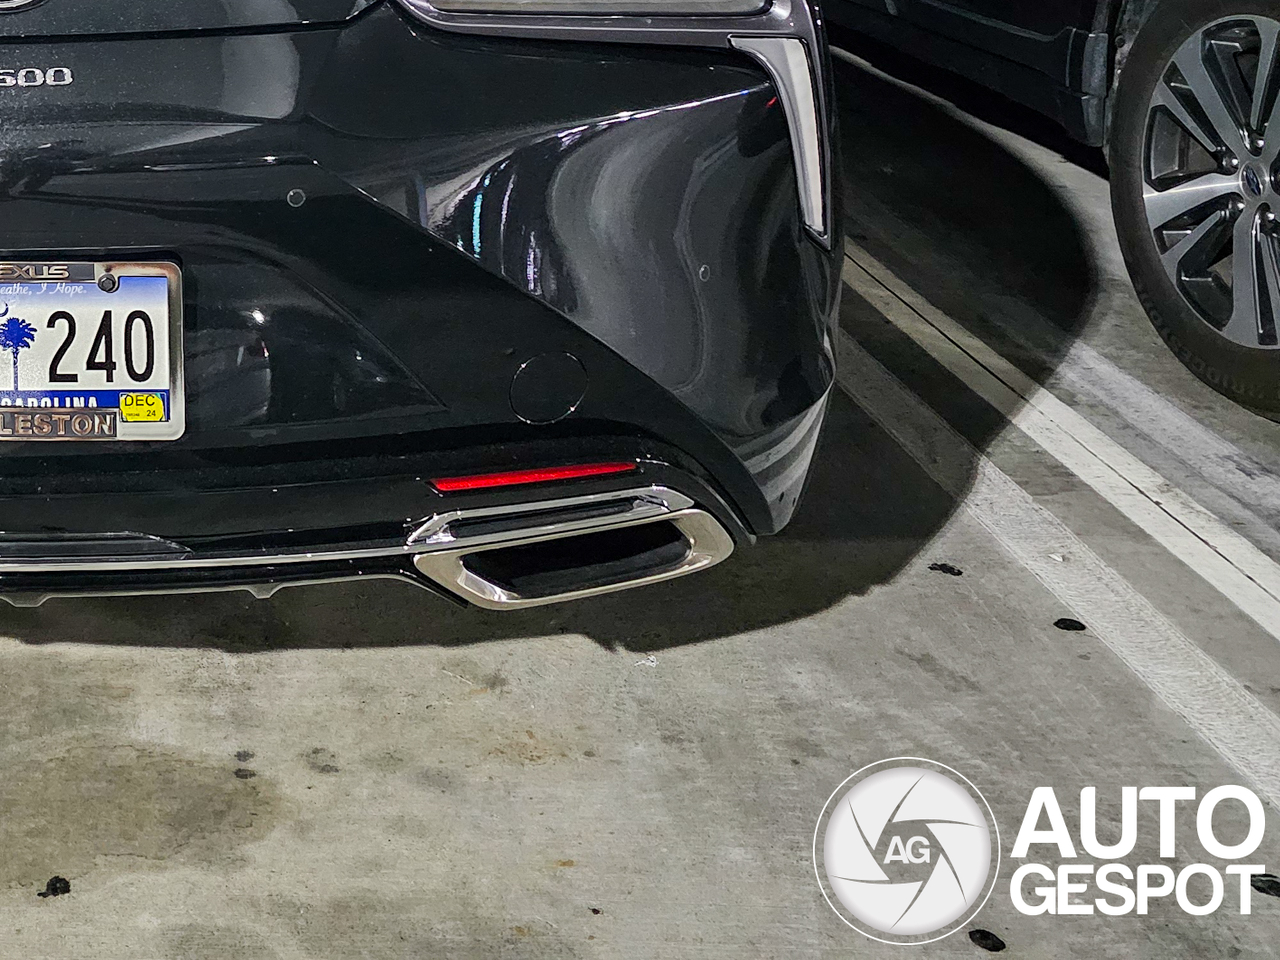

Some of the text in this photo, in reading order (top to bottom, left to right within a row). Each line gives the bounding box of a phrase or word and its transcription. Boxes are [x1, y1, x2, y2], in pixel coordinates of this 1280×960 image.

[46, 310, 154, 383] 240
[124, 394, 156, 407] DEC
[146, 409, 156, 417] 24
